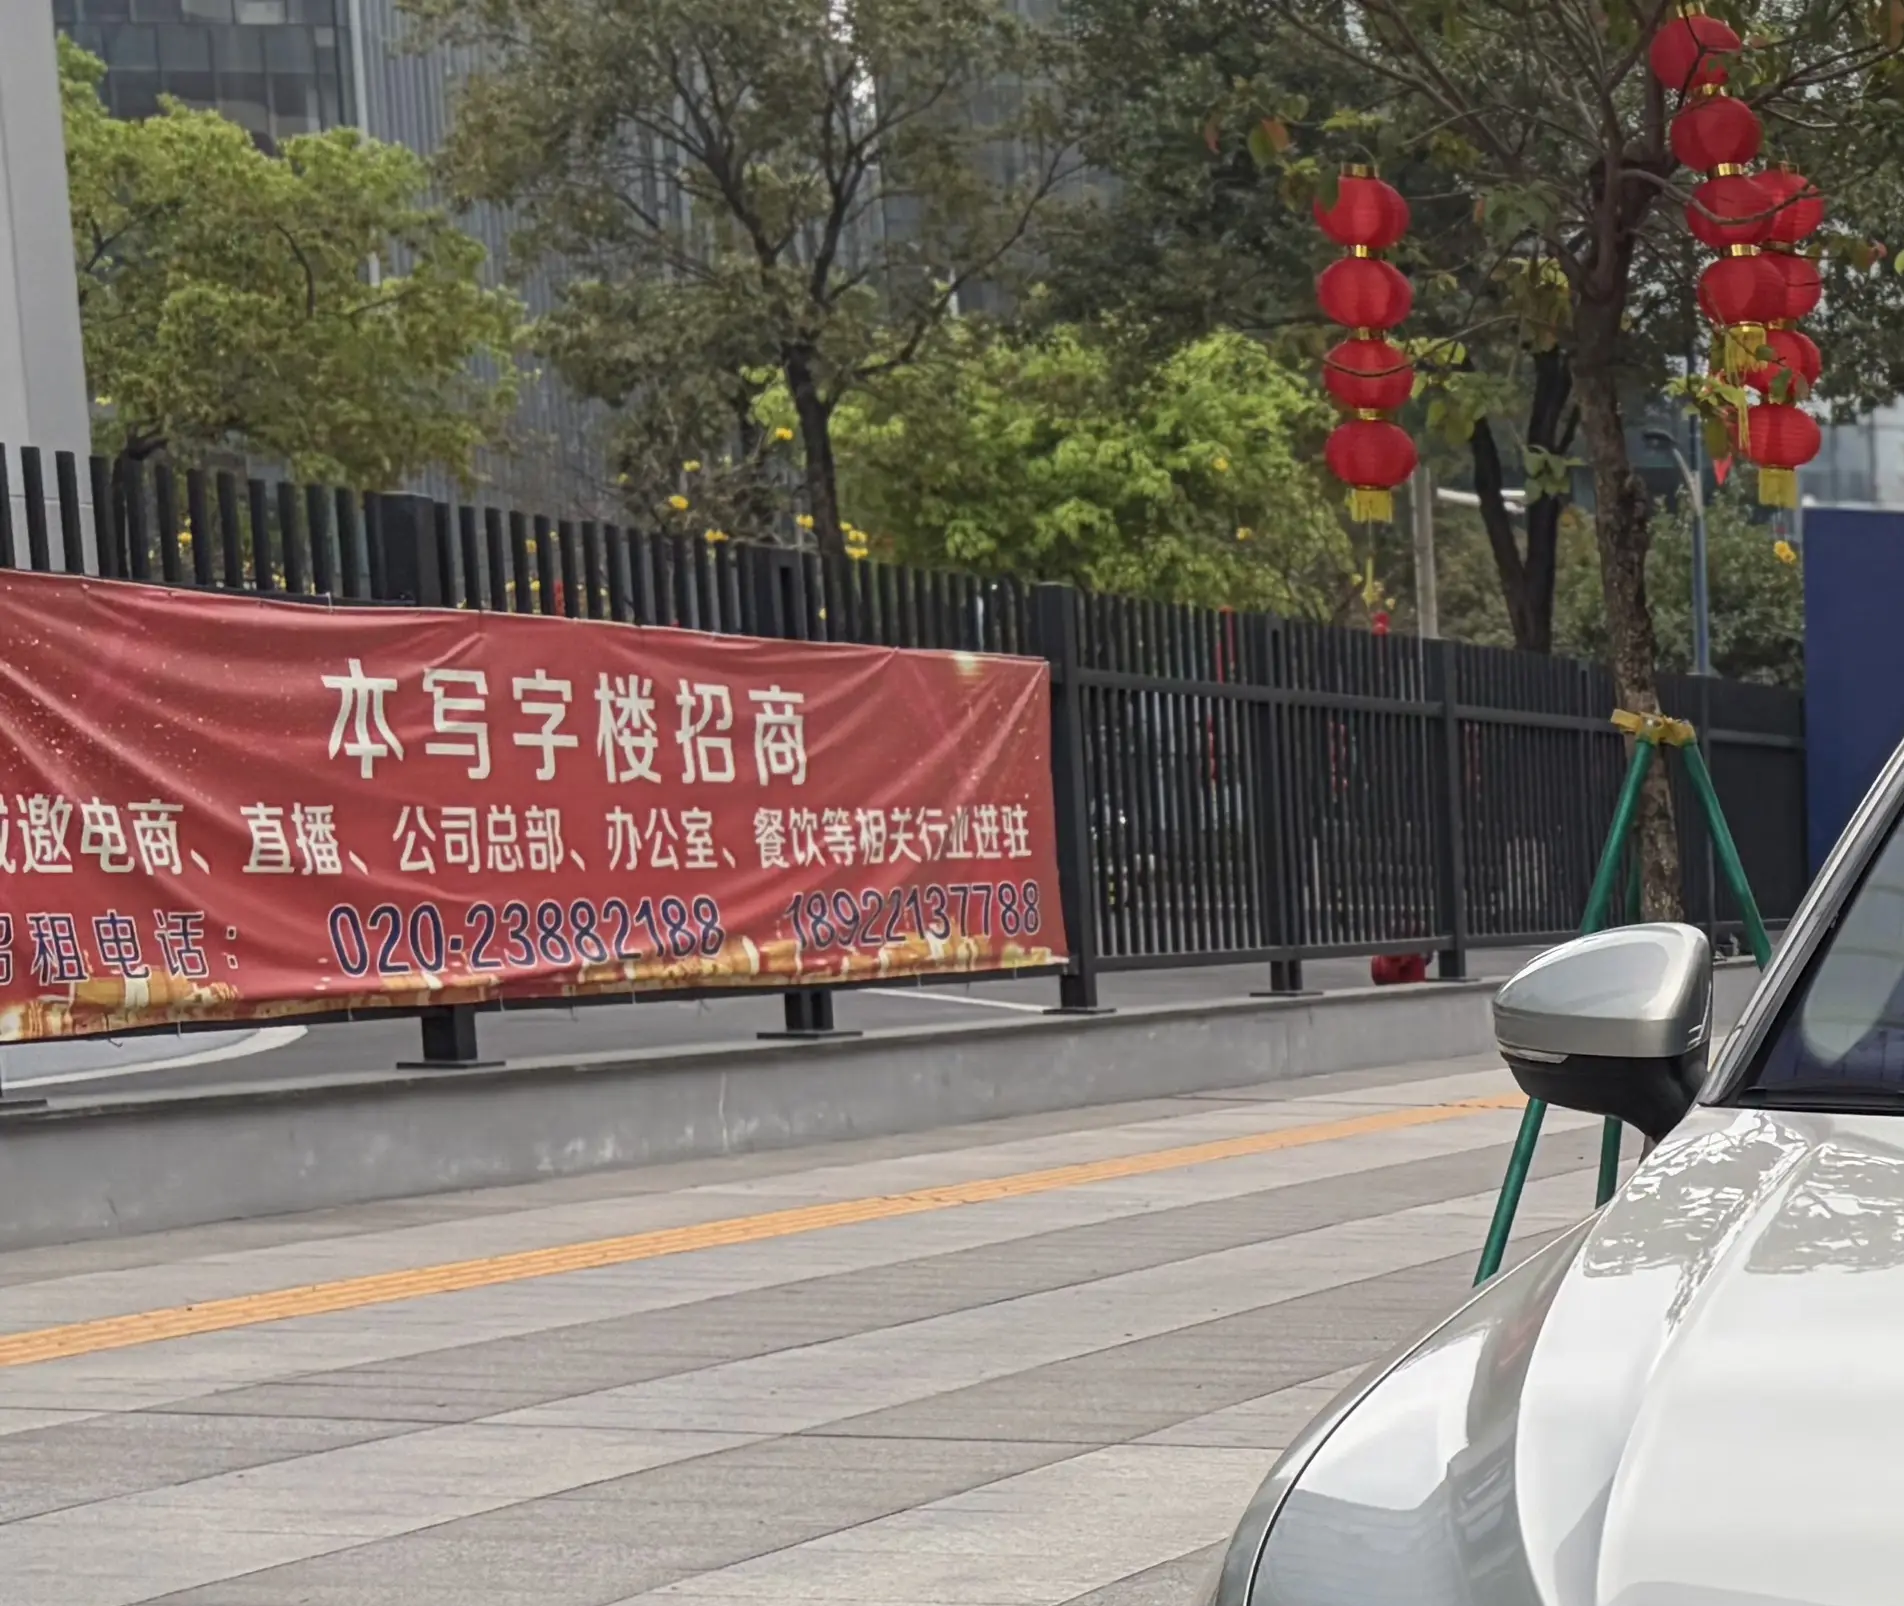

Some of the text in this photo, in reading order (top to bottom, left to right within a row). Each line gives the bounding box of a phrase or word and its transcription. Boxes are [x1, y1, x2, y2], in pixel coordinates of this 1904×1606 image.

[321, 658, 807, 786] 本写字楼招商
[785, 879, 1041, 950] 18922137788
